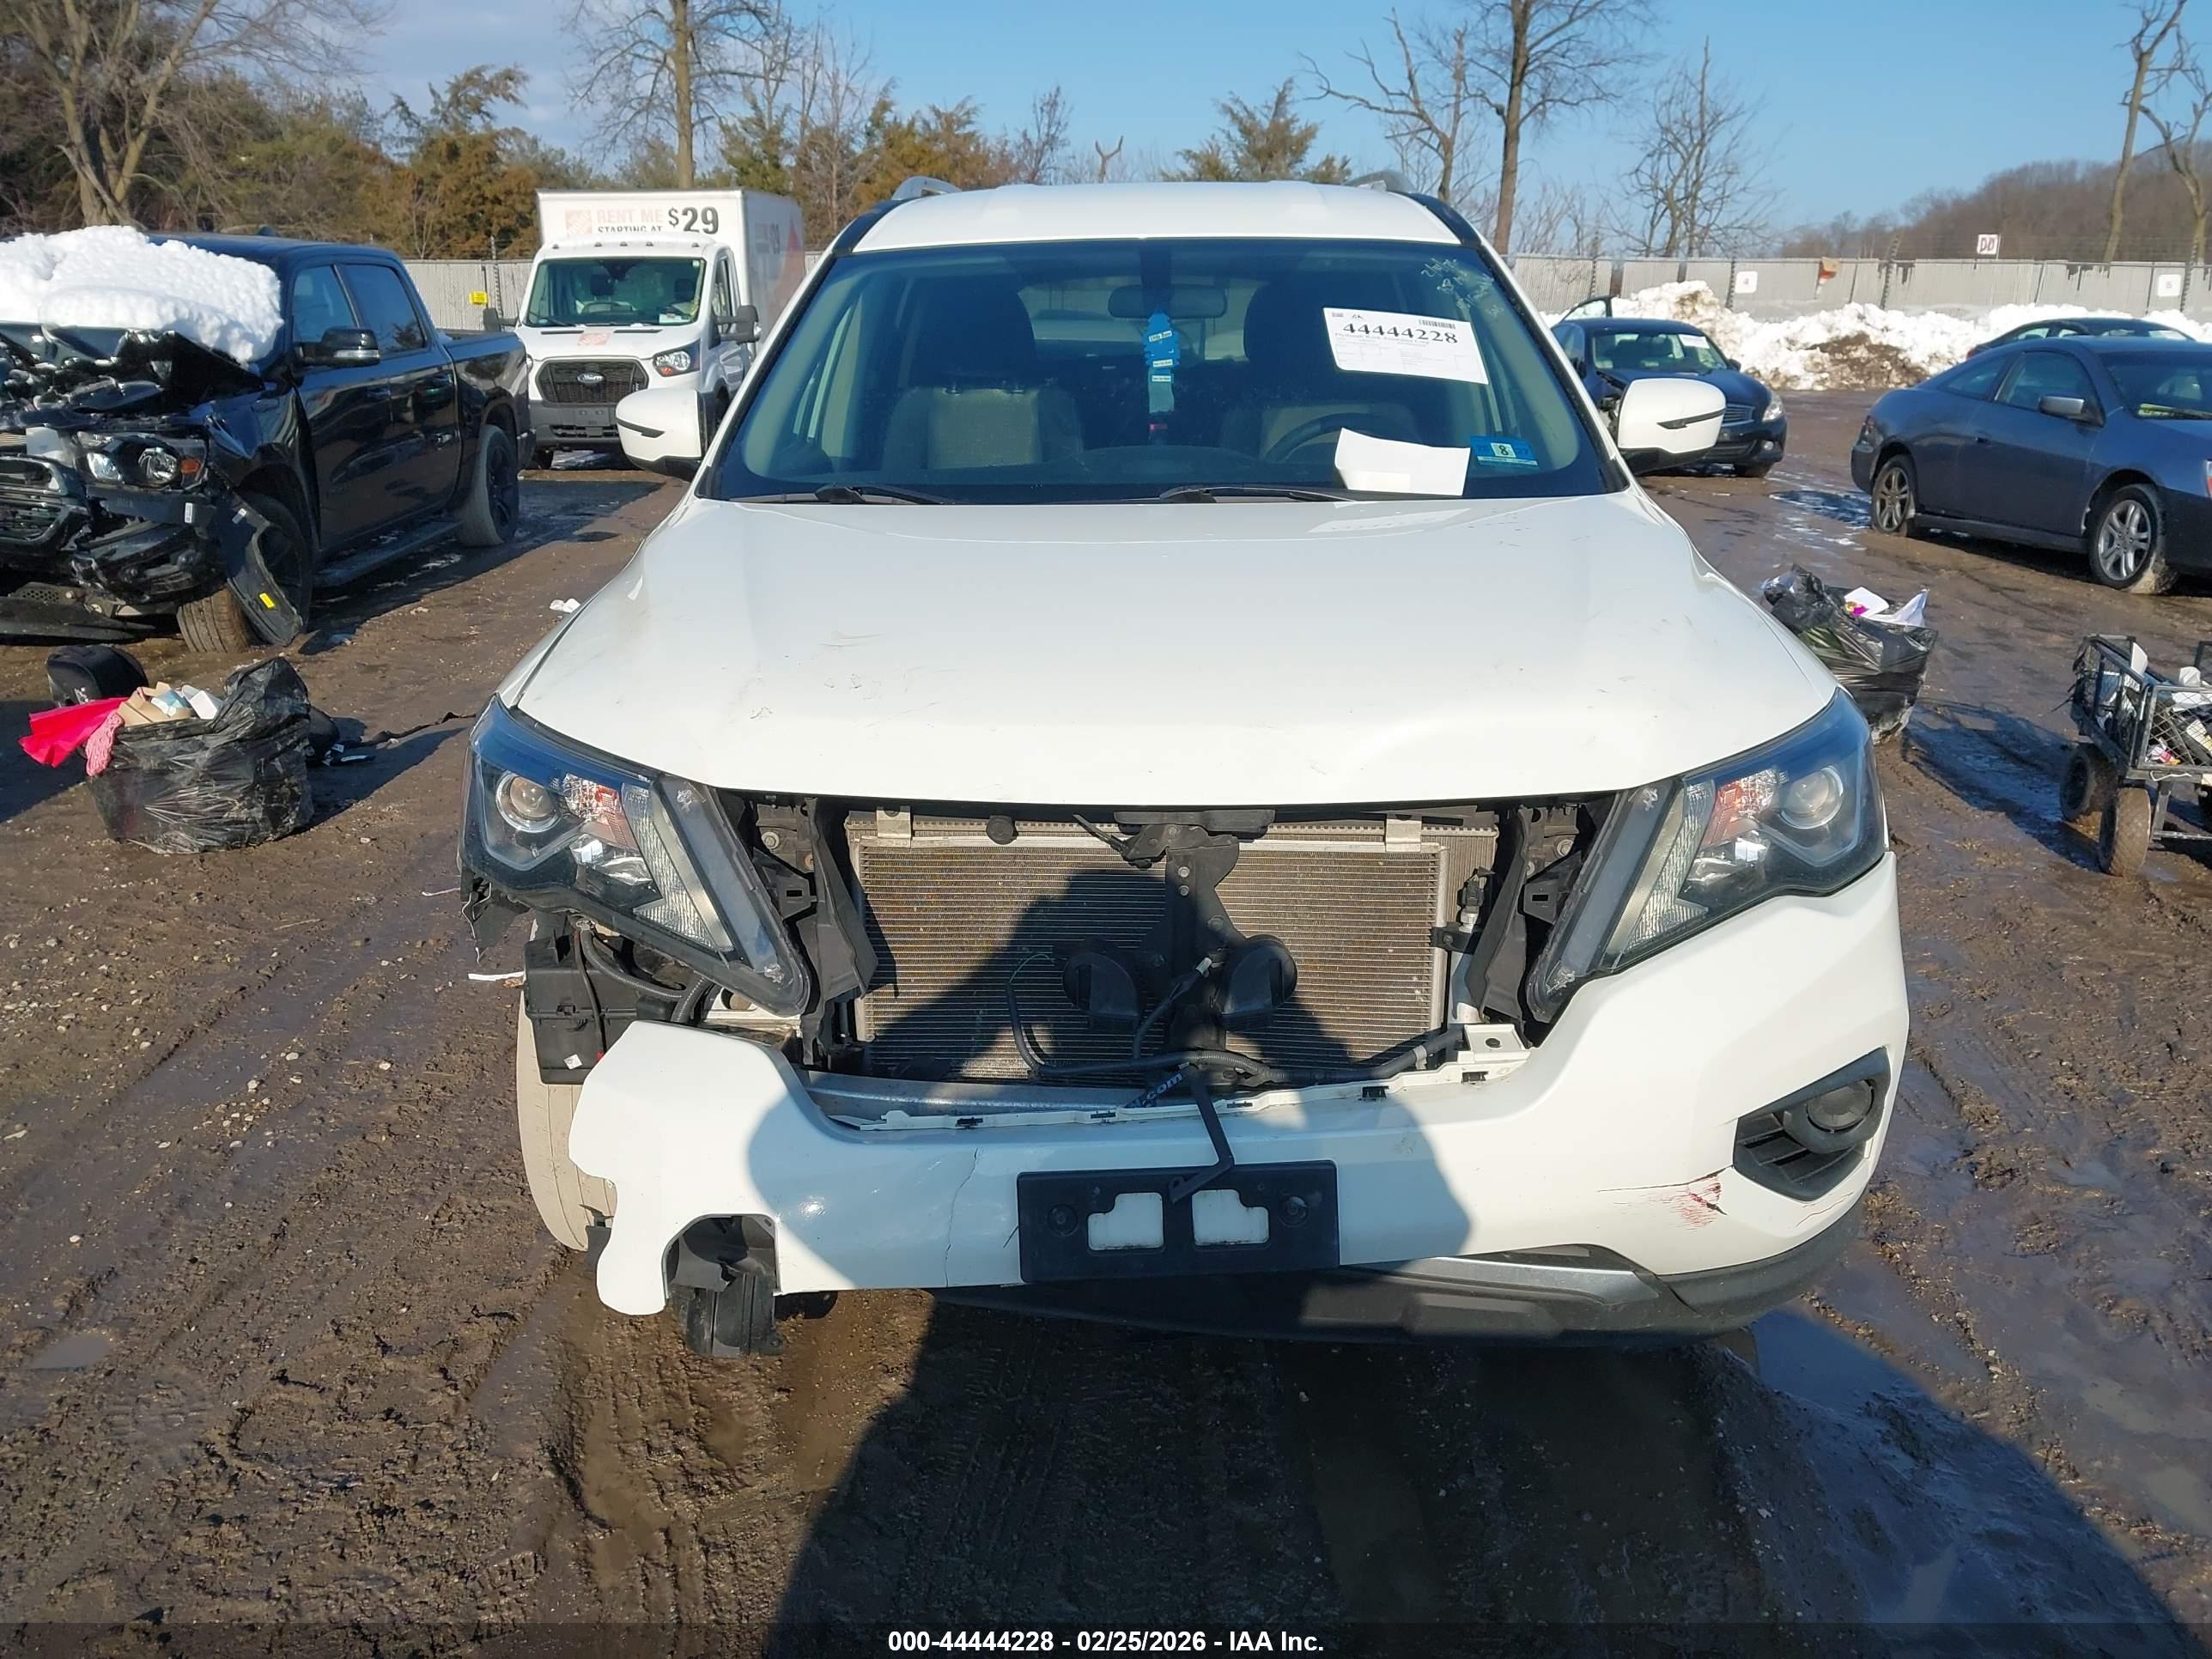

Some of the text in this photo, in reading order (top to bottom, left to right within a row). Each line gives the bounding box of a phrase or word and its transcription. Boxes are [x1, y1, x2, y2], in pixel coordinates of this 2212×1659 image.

[597, 209, 635, 223] RENT
[641, 208, 664, 223] ME
[668, 206, 720, 235] $29
[1343, 322, 1458, 344] 44444228
[1498, 445, 1509, 456] 8
